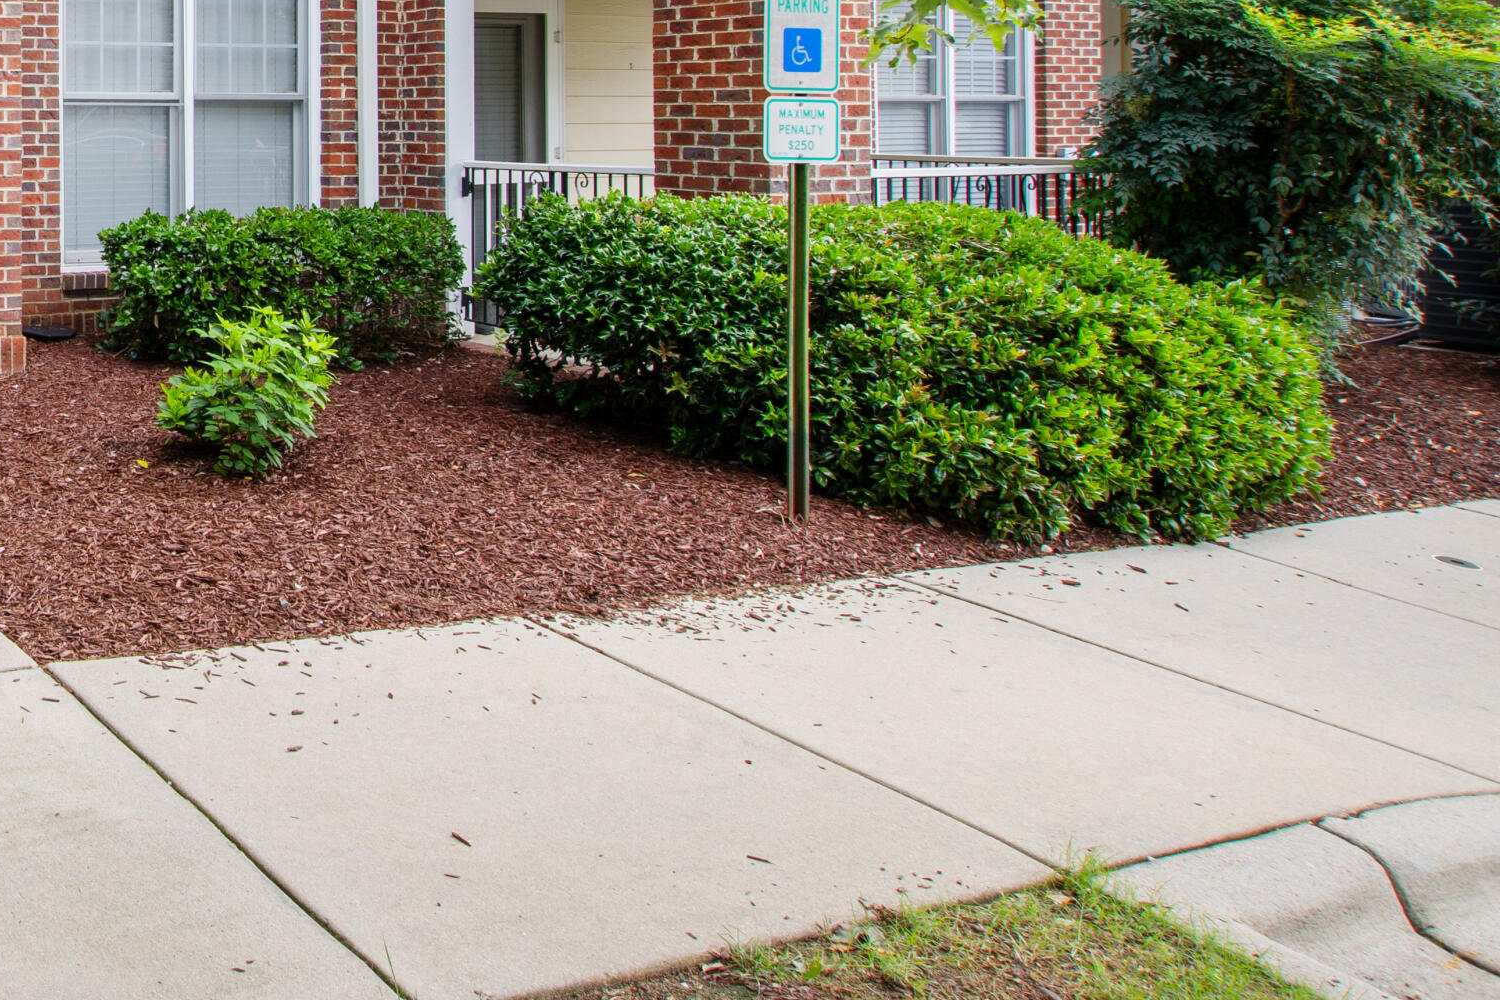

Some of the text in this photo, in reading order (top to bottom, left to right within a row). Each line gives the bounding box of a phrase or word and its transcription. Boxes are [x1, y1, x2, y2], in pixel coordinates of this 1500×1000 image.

[779, 108, 825, 119] MAXIMUM
[778, 124, 825, 135] PENALTY
[787, 139, 815, 151] $250
